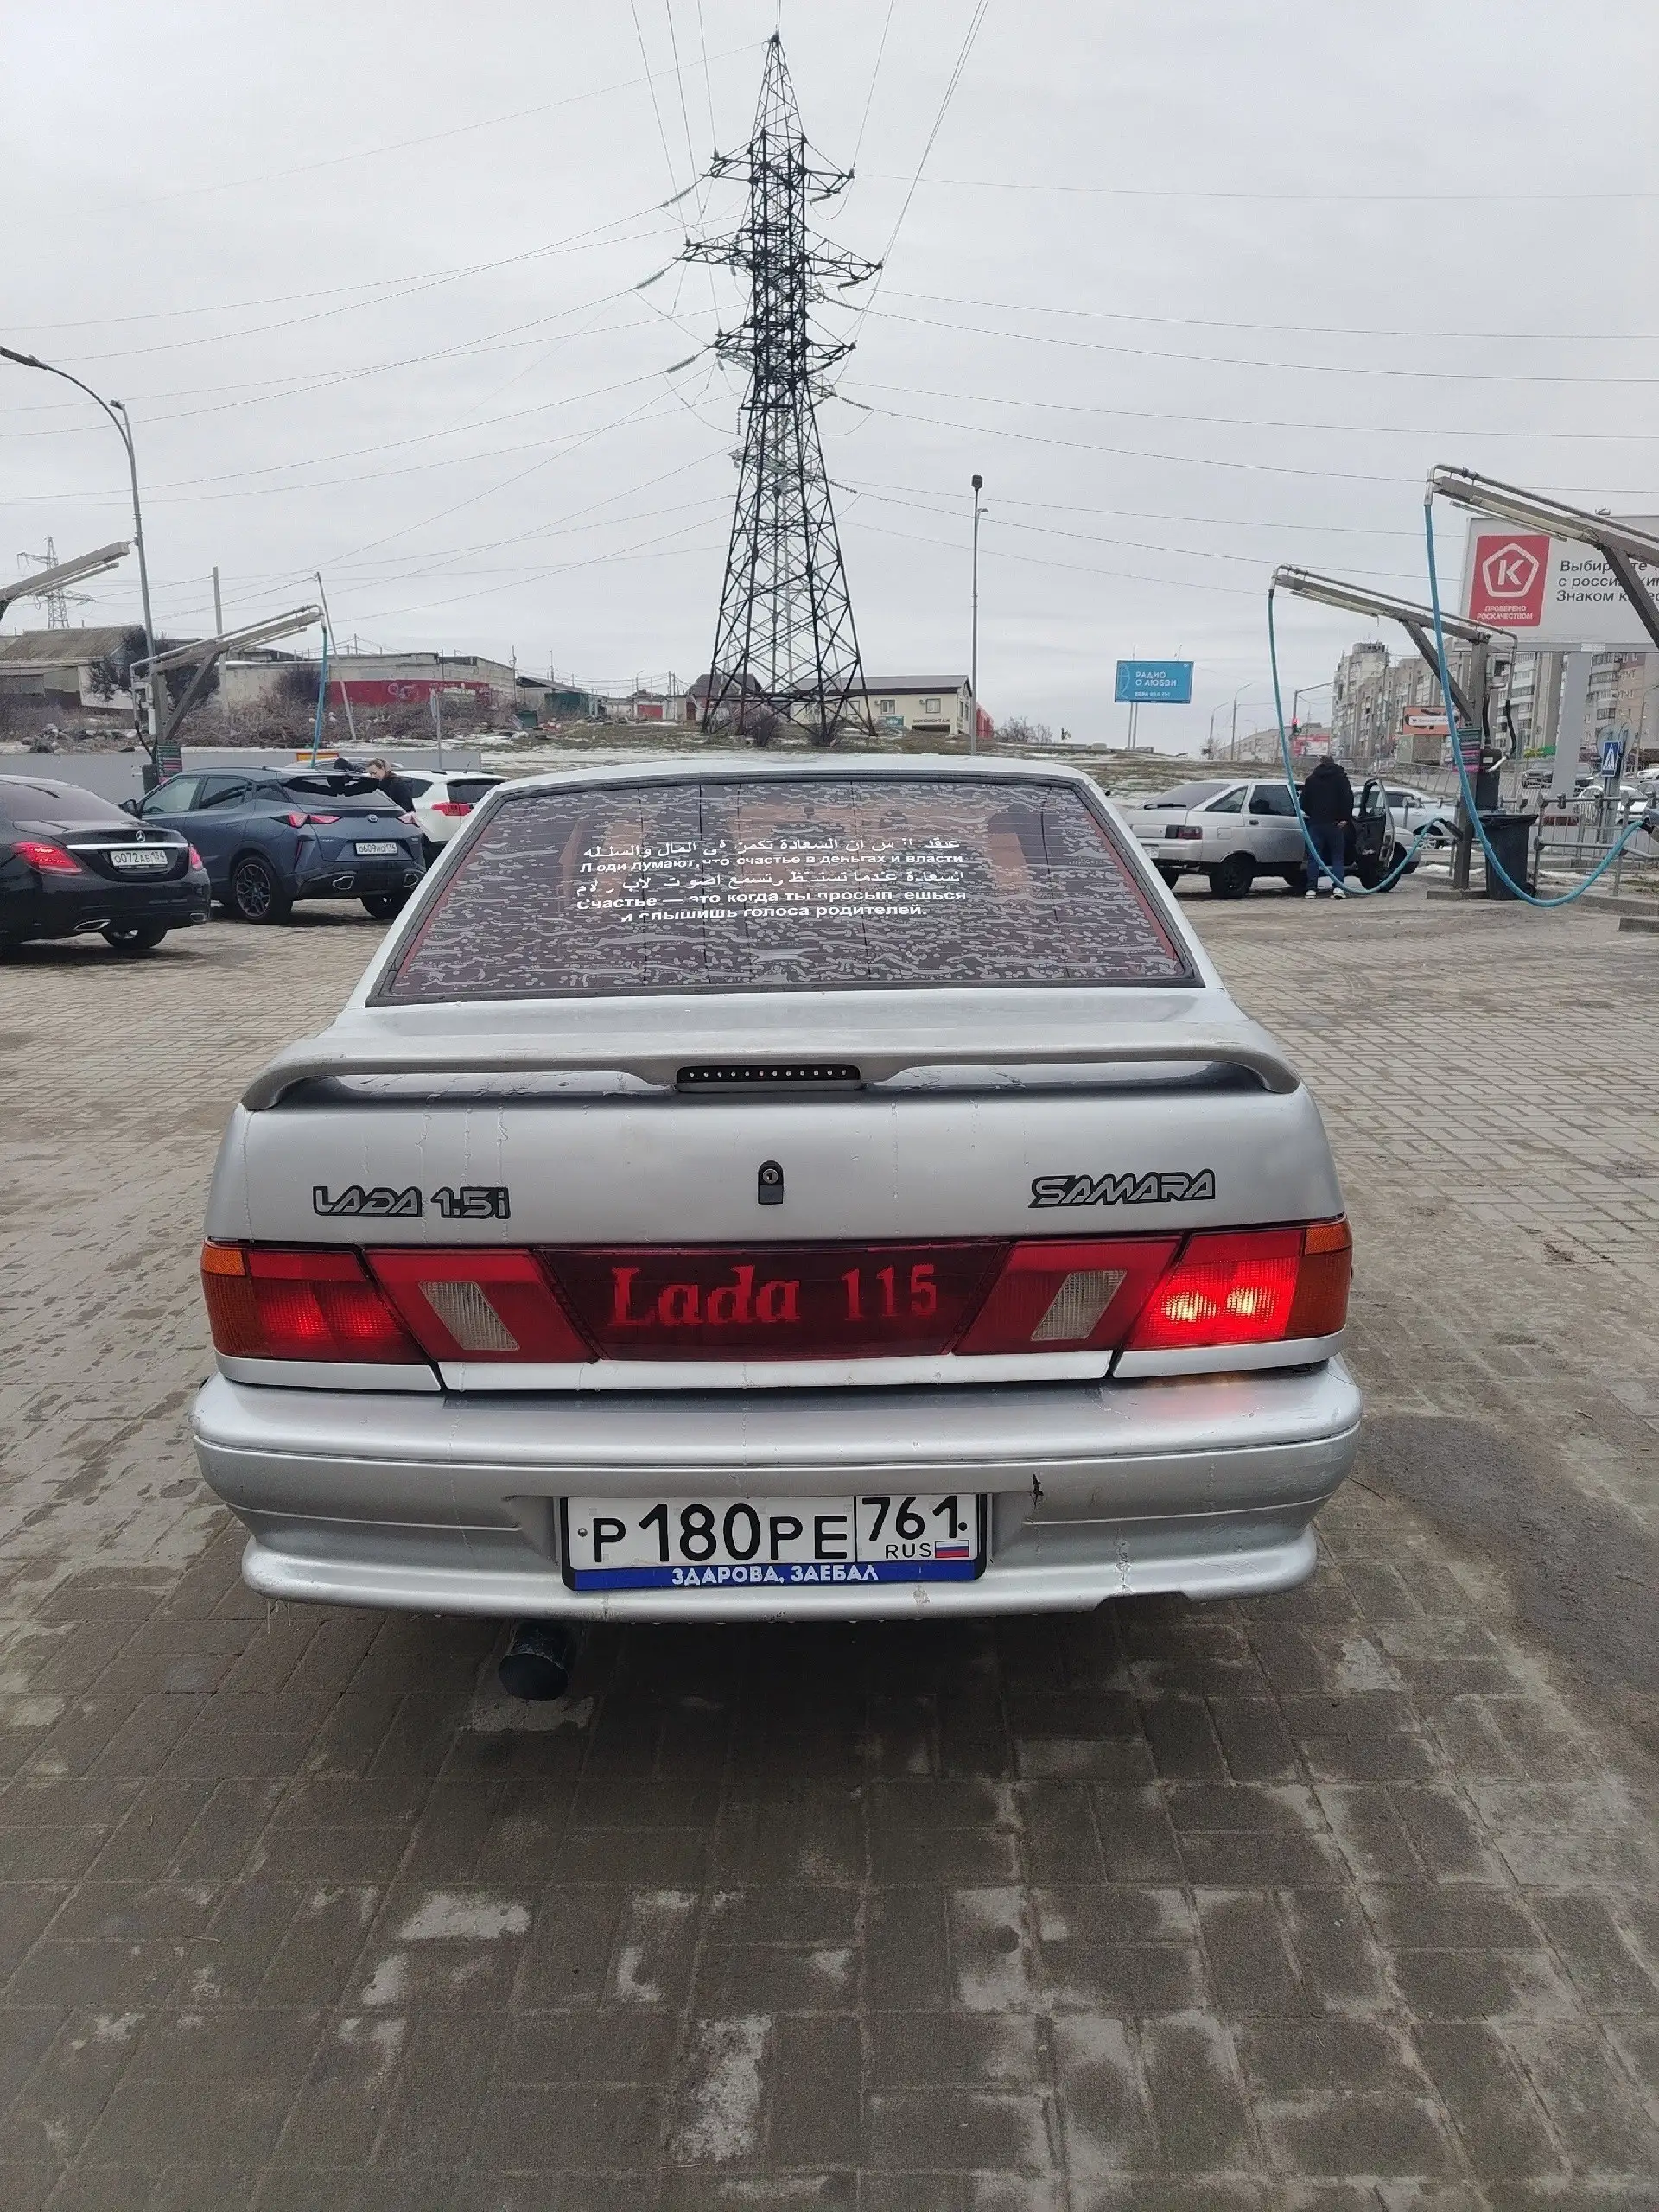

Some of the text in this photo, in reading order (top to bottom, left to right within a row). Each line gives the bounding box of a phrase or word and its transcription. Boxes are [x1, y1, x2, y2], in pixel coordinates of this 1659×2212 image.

[1560, 559, 1648, 575] Выбирте
[1558, 577, 1567, 587] с
[1556, 589, 1614, 601] Знаком
[736, 855, 801, 865] счастье
[805, 855, 816, 864] в
[891, 855, 900, 864] и
[906, 855, 963, 864] власти
[576, 896, 658, 910] Счастье
[727, 893, 779, 904] когда
[784, 893, 810, 902] ты
[743, 907, 810, 918] голоса
[816, 904, 928, 918] родителей.
[1028, 1168, 1216, 1208] SAMARA
[313, 1185, 423, 1217] LADA
[608, 1263, 938, 1327] Lada 115
[861, 1495, 957, 1541] 761
[885, 1542, 932, 1559] RUS
[671, 1564, 879, 1586] ЗДАРОВА, ЗАЕБАЛ
